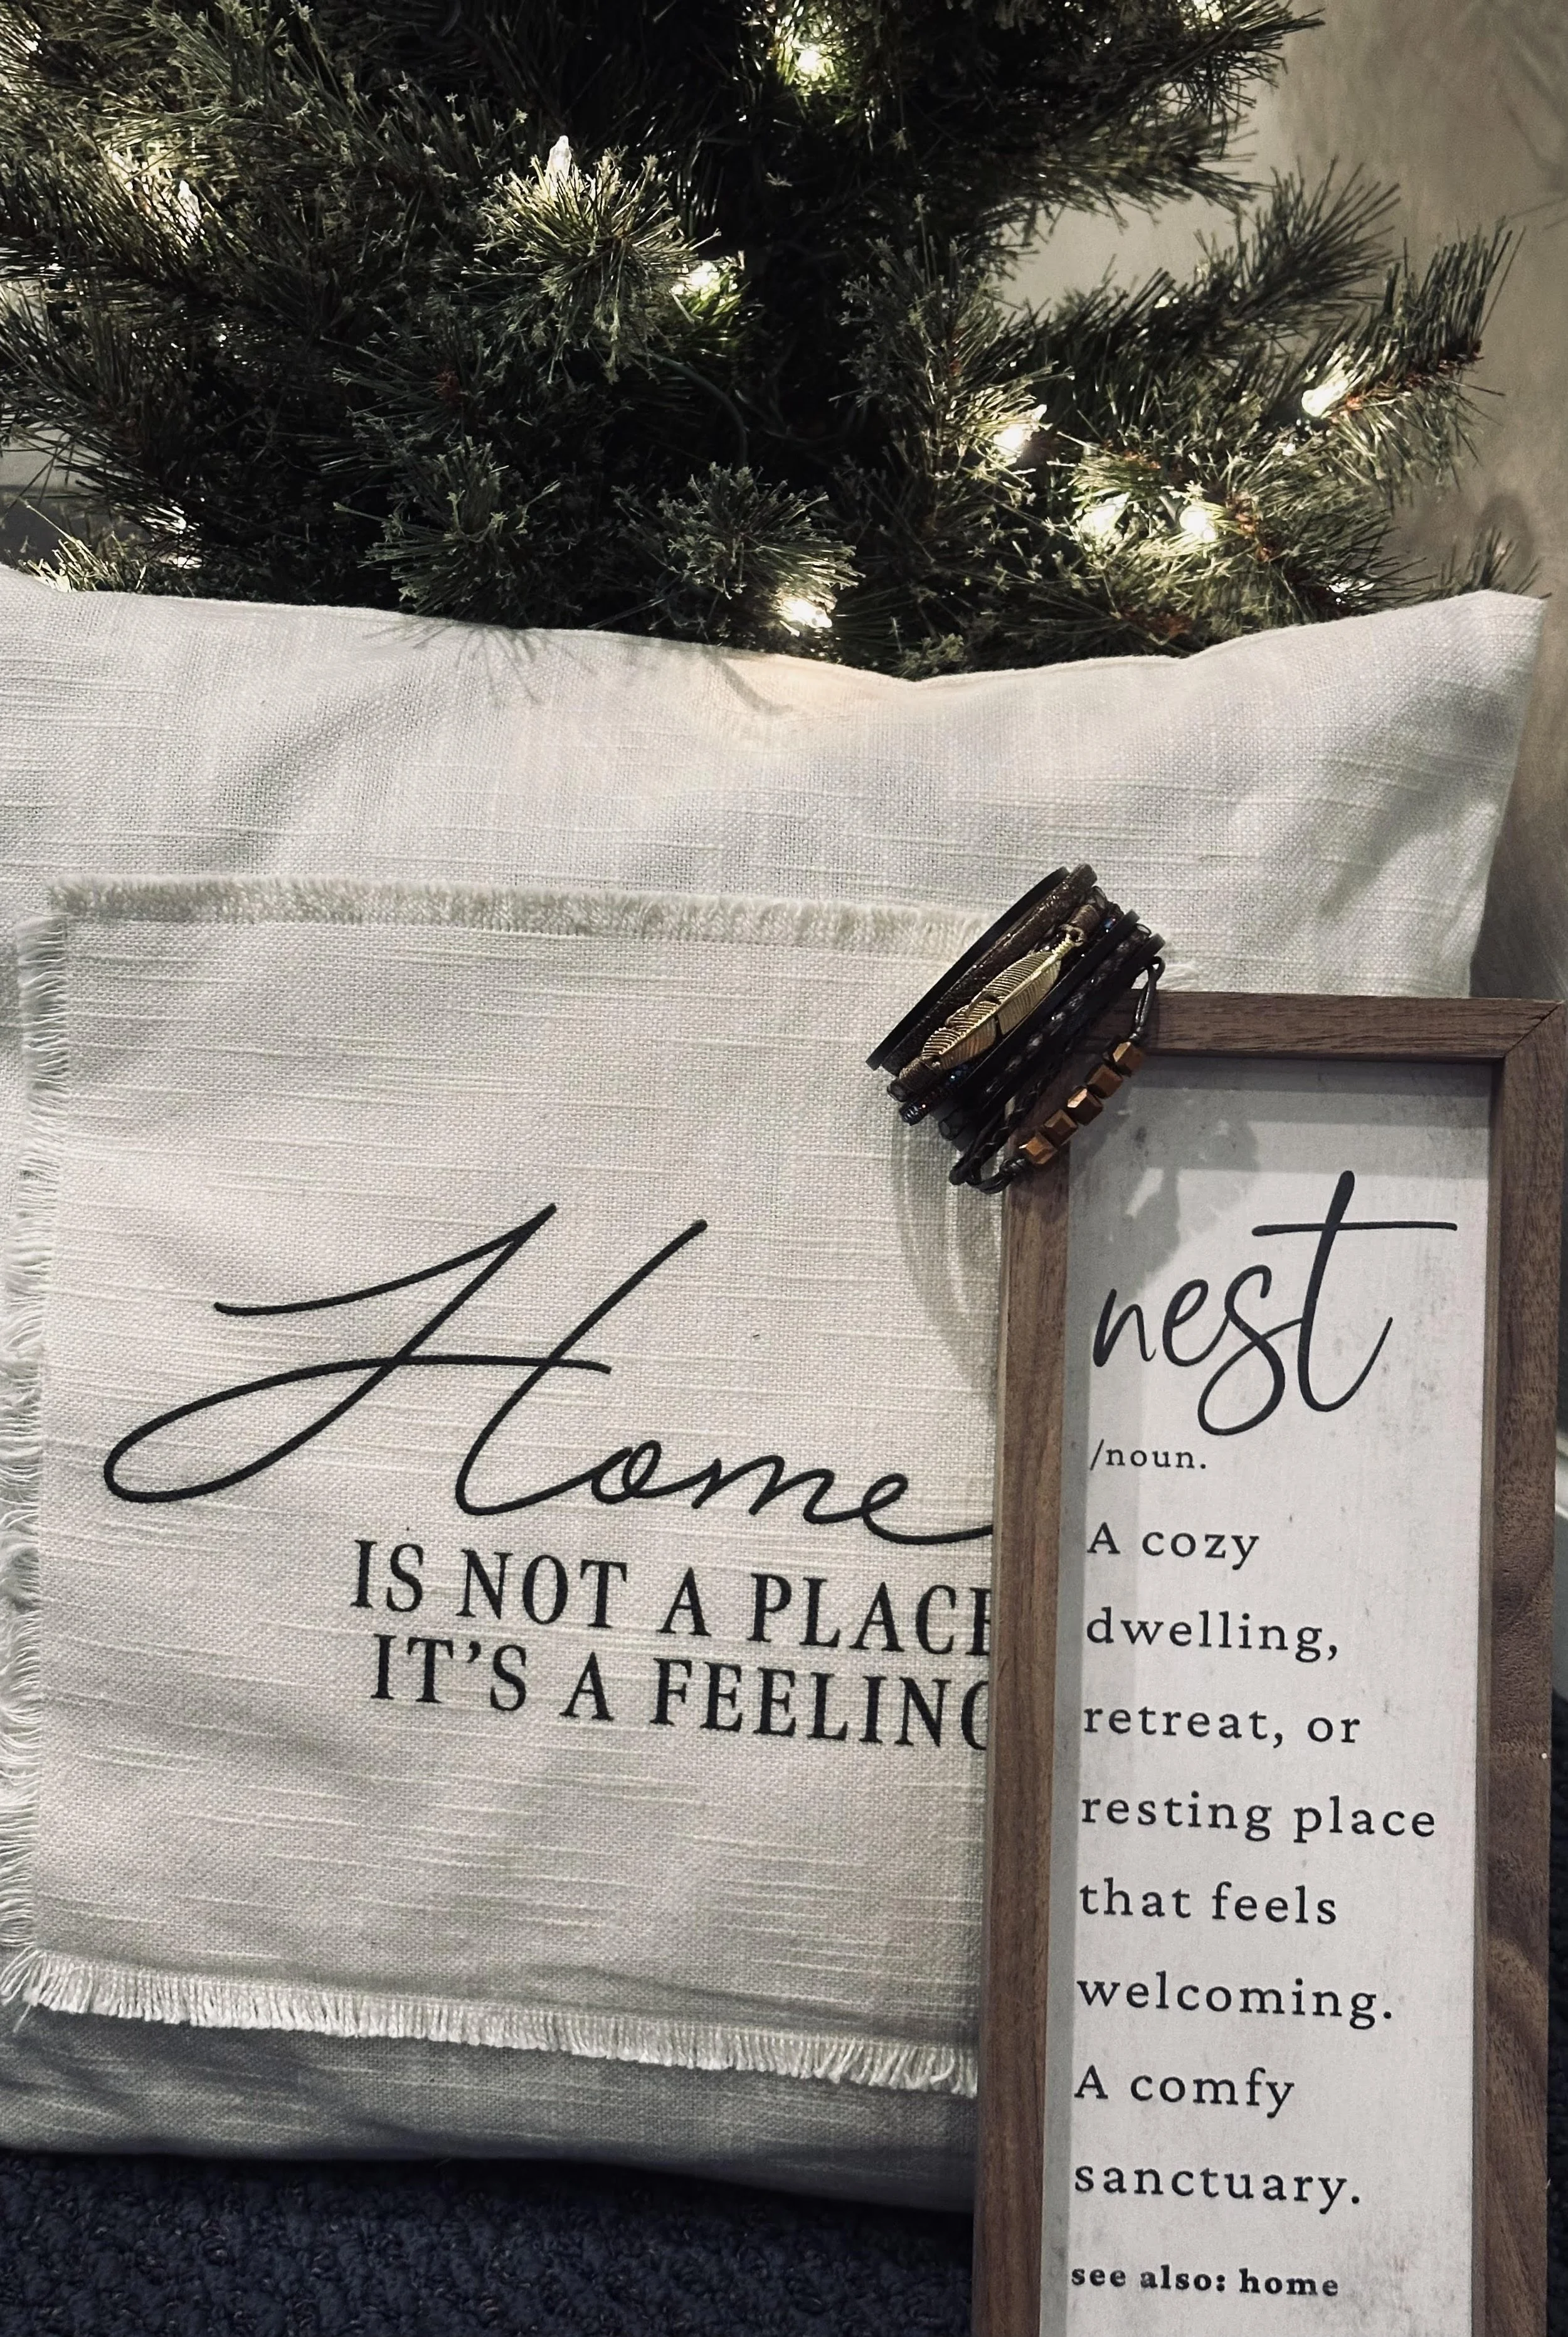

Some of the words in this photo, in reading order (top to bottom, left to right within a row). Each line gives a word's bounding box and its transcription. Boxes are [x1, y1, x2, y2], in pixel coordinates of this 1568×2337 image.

[1093, 1170, 1458, 1435] nest
[103, 1204, 993, 1545] Home
[1087, 1522, 1120, 1555] A
[1142, 1532, 1259, 1570] cozy
[350, 1540, 425, 1612] IS
[455, 1548, 627, 1629] NOT
[656, 1567, 711, 1637] A
[1087, 1606, 1337, 1663] dwelling,
[559, 1652, 614, 1722] A
[1084, 1706, 1283, 1749] retreat,
[1307, 1717, 1360, 1743] or
[1082, 1791, 1272, 1842] resting
[1293, 1795, 1434, 1843] place
[1079, 1877, 1191, 1919] that
[1212, 1881, 1336, 1925] feels
[1076, 1971, 1392, 2030] welcoming.
[1074, 2065, 1108, 2099] A
[1130, 2067, 1295, 2119] comfy
[1075, 2166, 1360, 2215] sanctuary.
[1071, 2269, 1126, 2287] see
[1140, 2264, 1226, 2292] also:
[1239, 2268, 1338, 2297] home
